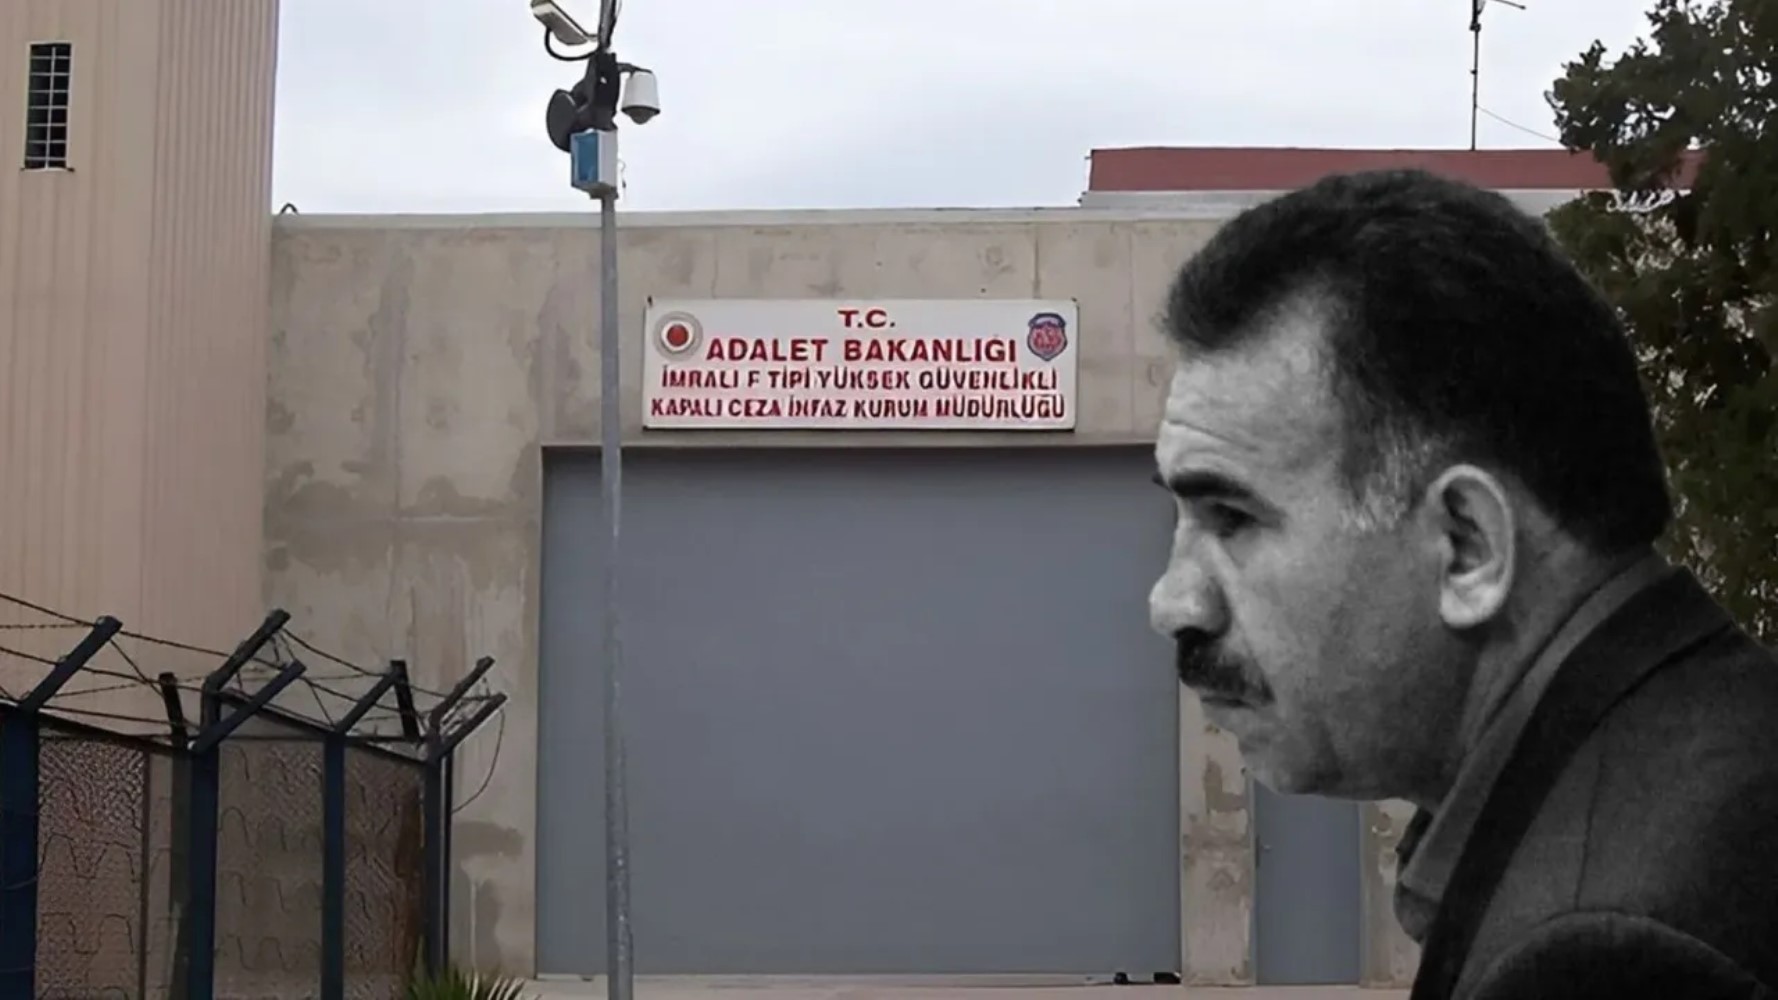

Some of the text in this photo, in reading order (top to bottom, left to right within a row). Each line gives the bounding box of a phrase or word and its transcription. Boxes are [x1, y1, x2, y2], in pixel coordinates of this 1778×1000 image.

[837, 309, 896, 328] T.C.
[706, 338, 829, 361] ADALET
[661, 364, 739, 388] İMRALI
[748, 370, 760, 388] F
[768, 365, 810, 389] TİPİ
[817, 365, 910, 390] YÜKSEK
[651, 397, 723, 417] KAPALI
[728, 398, 781, 417] CEZA
[853, 399, 928, 418] KURUM
